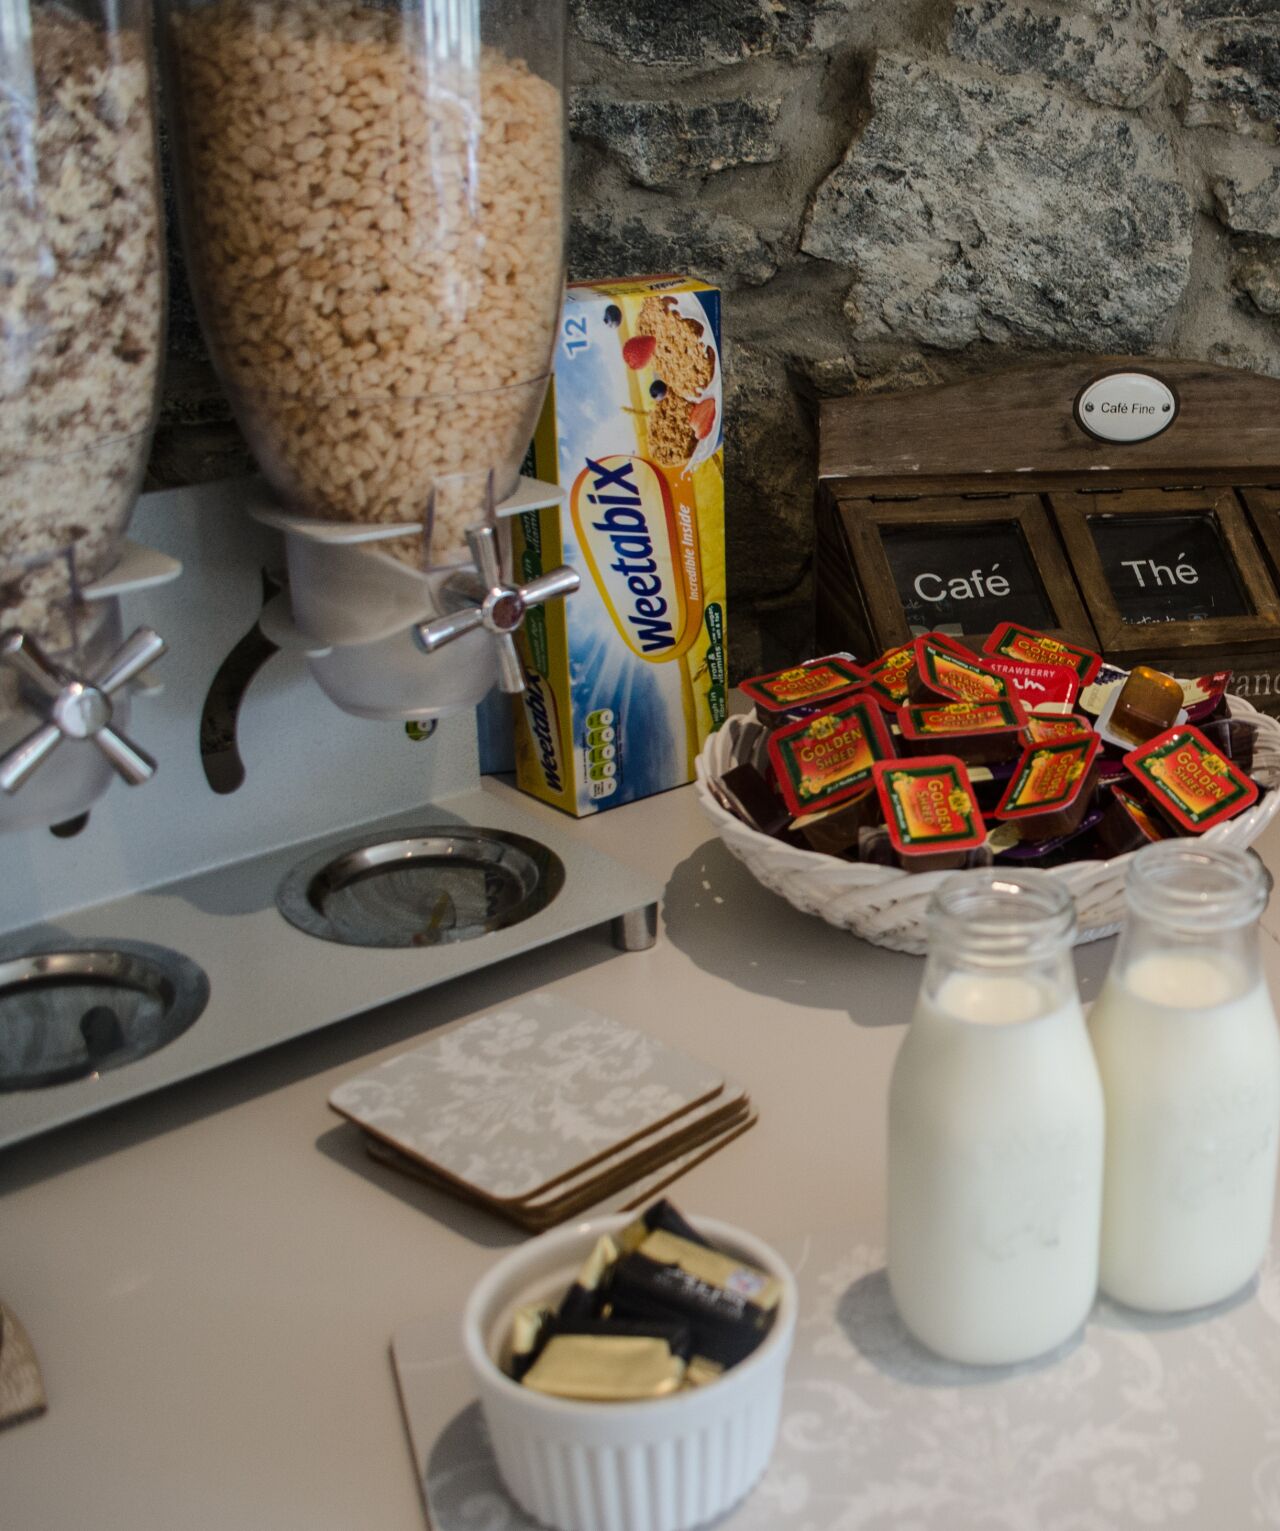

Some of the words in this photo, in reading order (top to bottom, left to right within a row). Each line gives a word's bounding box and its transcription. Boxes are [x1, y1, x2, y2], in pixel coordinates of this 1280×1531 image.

[564, 316, 588, 357] 12
[1101, 401, 1128, 414] Café
[1131, 402, 1156, 415] Fine
[677, 503, 694, 547] Inside
[585, 456, 677, 653] Weetabix
[1120, 552, 1199, 588] Thé
[682, 547, 699, 601] Incredible
[914, 562, 1011, 602] Café
[989, 663, 1056, 678] STRAWBERRY
[928, 710, 998, 723] GOLDEN
[800, 728, 863, 762] GOLDEN
[815, 747, 856, 770] SHRED
[1173, 765, 1205, 797] SHRED
[1176, 751, 1225, 799] GOLDEN
[927, 779, 954, 834] GOLDEN
